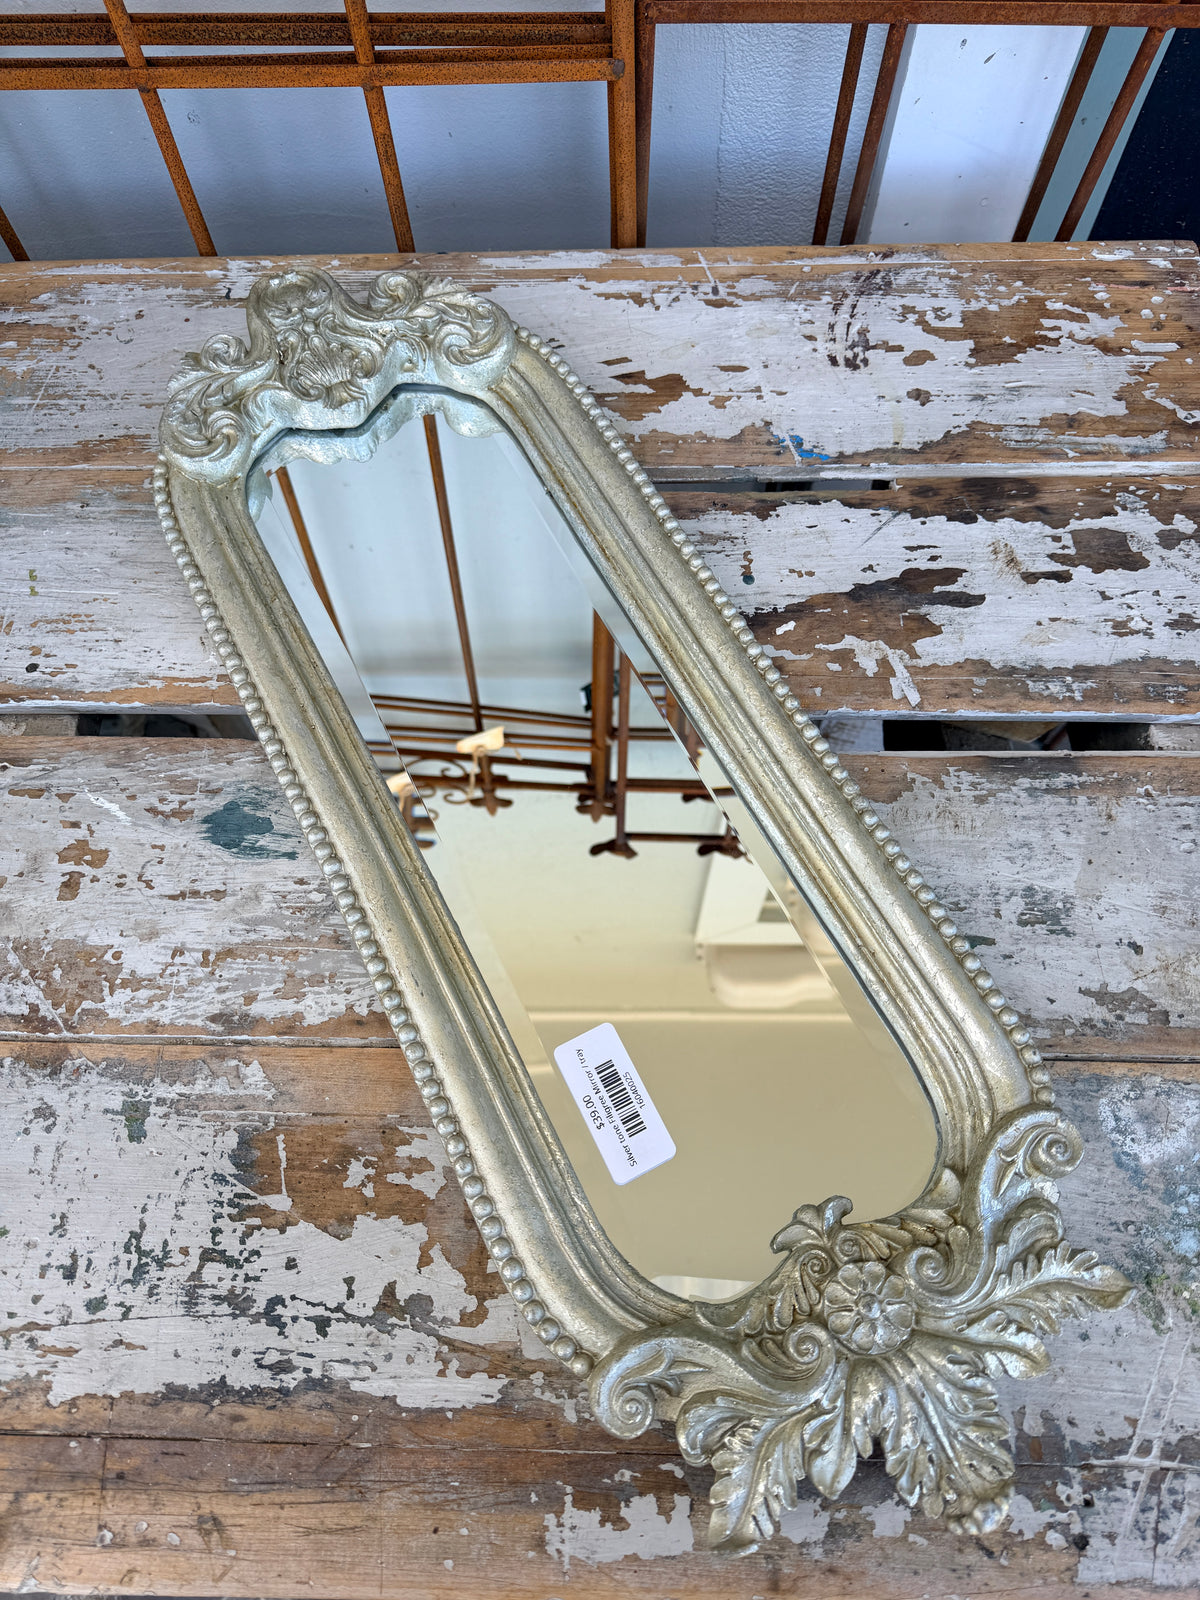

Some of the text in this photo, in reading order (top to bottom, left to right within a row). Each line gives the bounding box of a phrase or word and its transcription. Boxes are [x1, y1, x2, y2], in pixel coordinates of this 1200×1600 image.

[575, 1048, 586, 1065] tray
[584, 1070, 602, 1096] Mirror
[622, 1071, 646, 1110] 16040025
[582, 1094, 606, 1131] $39.00
[598, 1094, 616, 1125] Filigree
[612, 1124, 626, 1144] tone
[622, 1144, 638, 1167] Silver
